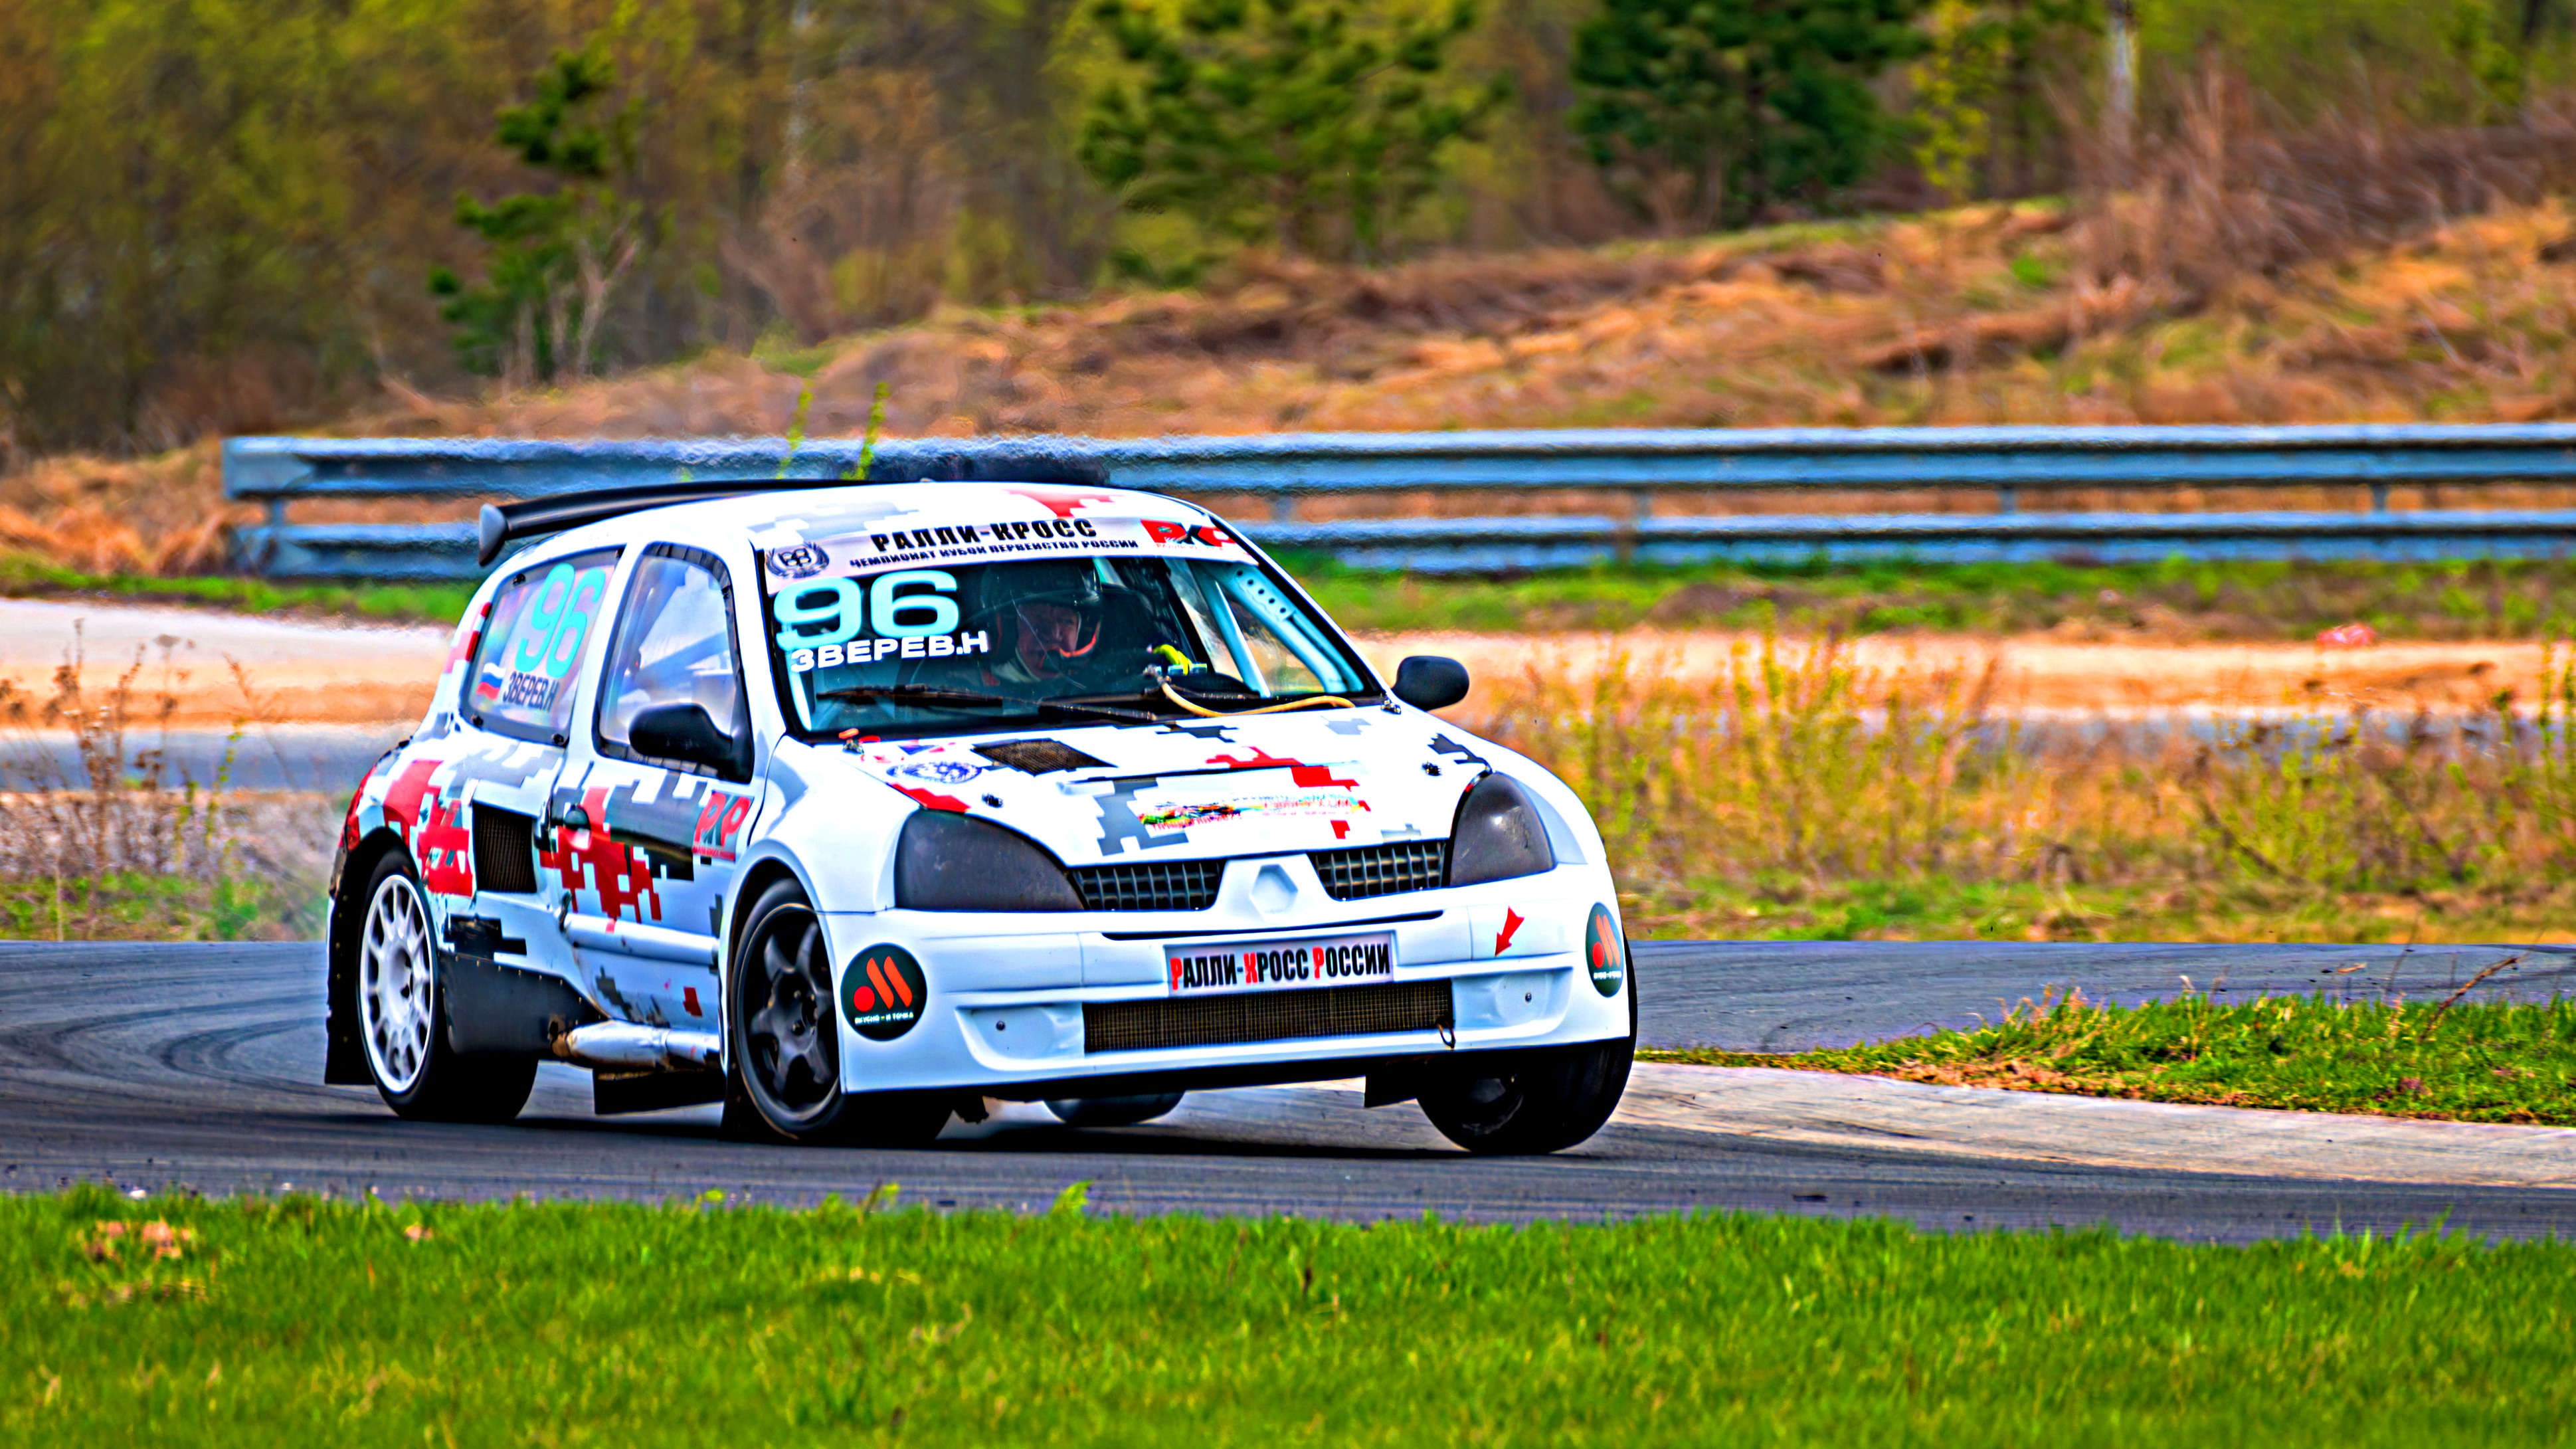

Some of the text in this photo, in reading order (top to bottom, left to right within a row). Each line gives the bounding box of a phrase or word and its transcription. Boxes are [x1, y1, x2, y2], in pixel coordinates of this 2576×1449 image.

[850, 550, 936, 567] ЧЕМПИОНАТ
[988, 541, 1079, 553] ПЕРВЕНСТВО
[1081, 539, 1139, 549] РОССИИ
[871, 518, 1097, 551] РАЛЛИ-КРОСС
[515, 563, 606, 678] 96
[773, 570, 959, 651] 96
[790, 630, 988, 672] ЗВЕРЕВ.Н
[1170, 943, 1390, 991] РАЛЛИ-КРОСС РОССИИ
